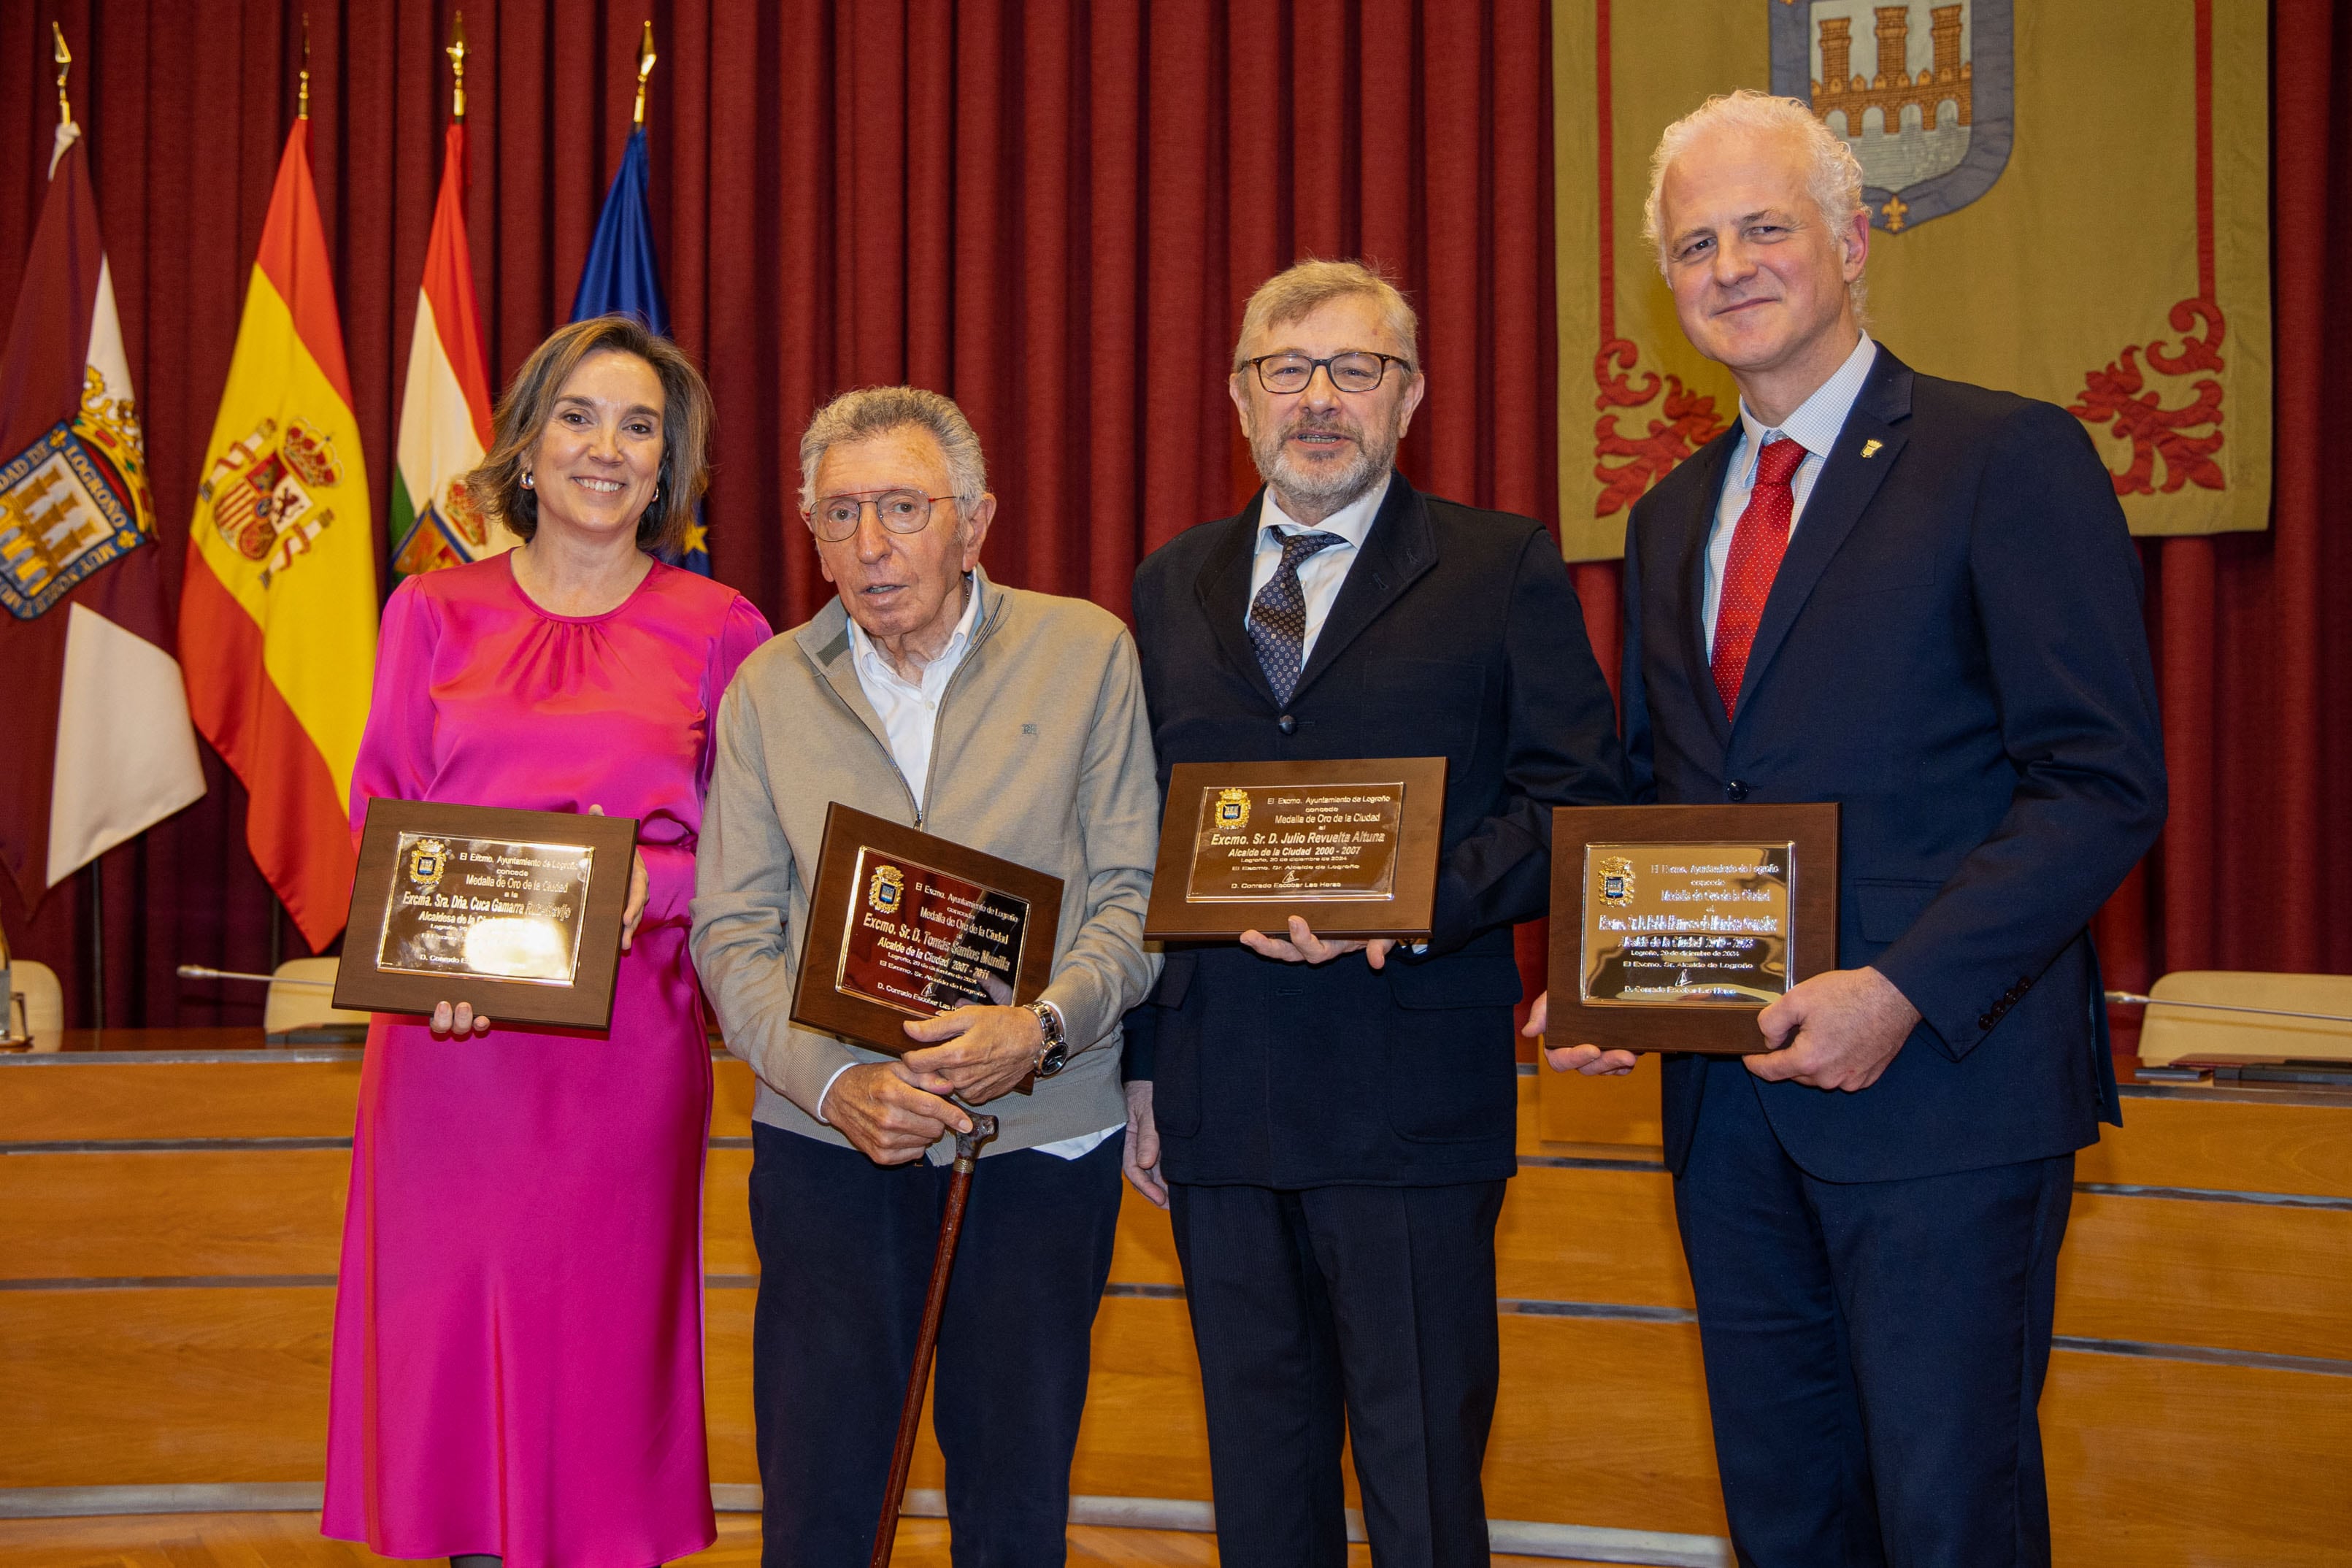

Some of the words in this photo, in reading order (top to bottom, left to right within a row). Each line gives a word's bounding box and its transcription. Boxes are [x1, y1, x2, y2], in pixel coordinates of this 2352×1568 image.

[26, 442, 50, 466] DE
[64, 445, 128, 527] LOGROÑO
[79, 543, 117, 572] MUY
[1305, 796, 1351, 805] Ayuntamiento
[1362, 795, 1391, 804] Logroño
[1275, 815, 1304, 823] Medalla
[1305, 815, 1315, 823] de
[1317, 814, 1332, 823] Oro
[1333, 814, 1343, 823] de
[1344, 813, 1352, 823] la
[1353, 812, 1380, 822] Ciudad
[1211, 834, 1249, 845] Excmo.
[1253, 833, 1266, 845] Sr.
[1268, 833, 1278, 844] D.
[1280, 832, 1305, 844] Julio
[1307, 831, 1350, 843] Revuelta
[1351, 831, 1386, 842] Altuna
[1228, 848, 1259, 857] Alcalde
[1260, 848, 1271, 857] de
[1272, 848, 1280, 856] la
[1282, 848, 1312, 856] Ciudad
[1315, 847, 1334, 856] 2000
[1341, 846, 1361, 855] 2007
[460, 852, 467, 861] El
[469, 853, 493, 864] Excmo.
[496, 855, 542, 868] Ayuntamiento
[496, 869, 529, 877] concede
[466, 874, 494, 887] Medalla
[496, 876, 506, 888] de
[507, 877, 522, 890] Oro
[522, 879, 533, 890] de
[534, 880, 541, 891] la
[402, 891, 432, 907] Excma.
[434, 893, 450, 908] Sra.
[450, 894, 469, 910] Dña.
[469, 896, 491, 912] Cuca
[491, 898, 525, 915] Gamarra
[511, 891, 519, 899] la
[915, 882, 923, 891] El
[924, 885, 946, 899] Excmo.
[948, 893, 986, 912] Ayuntamiento
[986, 905, 995, 915] de
[995, 907, 1019, 923] Logroño
[418, 910, 456, 924] Alcaldesa
[456, 913, 467, 925] de
[920, 906, 945, 925] Medalla
[946, 915, 956, 927] de
[956, 918, 969, 931] Oro
[969, 923, 978, 934] de
[978, 925, 985, 937] la
[985, 928, 1009, 945] Ciudad
[863, 912, 896, 935] Excmo.
[899, 923, 911, 939] Sr.
[911, 927, 922, 943] D.
[923, 931, 950, 952] Tomás
[950, 940, 980, 962] Santos
[980, 949, 1010, 972] Munilla
[420, 953, 428, 961] D.
[877, 937, 905, 953] Alcalde
[905, 945, 916, 957] de
[915, 948, 923, 959] la
[923, 951, 950, 967] Ciudad
[951, 959, 970, 974] 2007
[888, 951, 912, 964] Logroño,
[1719, 962, 1753, 970] Logroño
[880, 959, 888, 967] El
[888, 961, 913, 975] Excmo.
[959, 984, 987, 998] Logroño
[877, 982, 885, 991] D.
[885, 984, 912, 999] Conrado
[912, 993, 939, 1007] Escobar
[939, 1002, 951, 1010] Las
